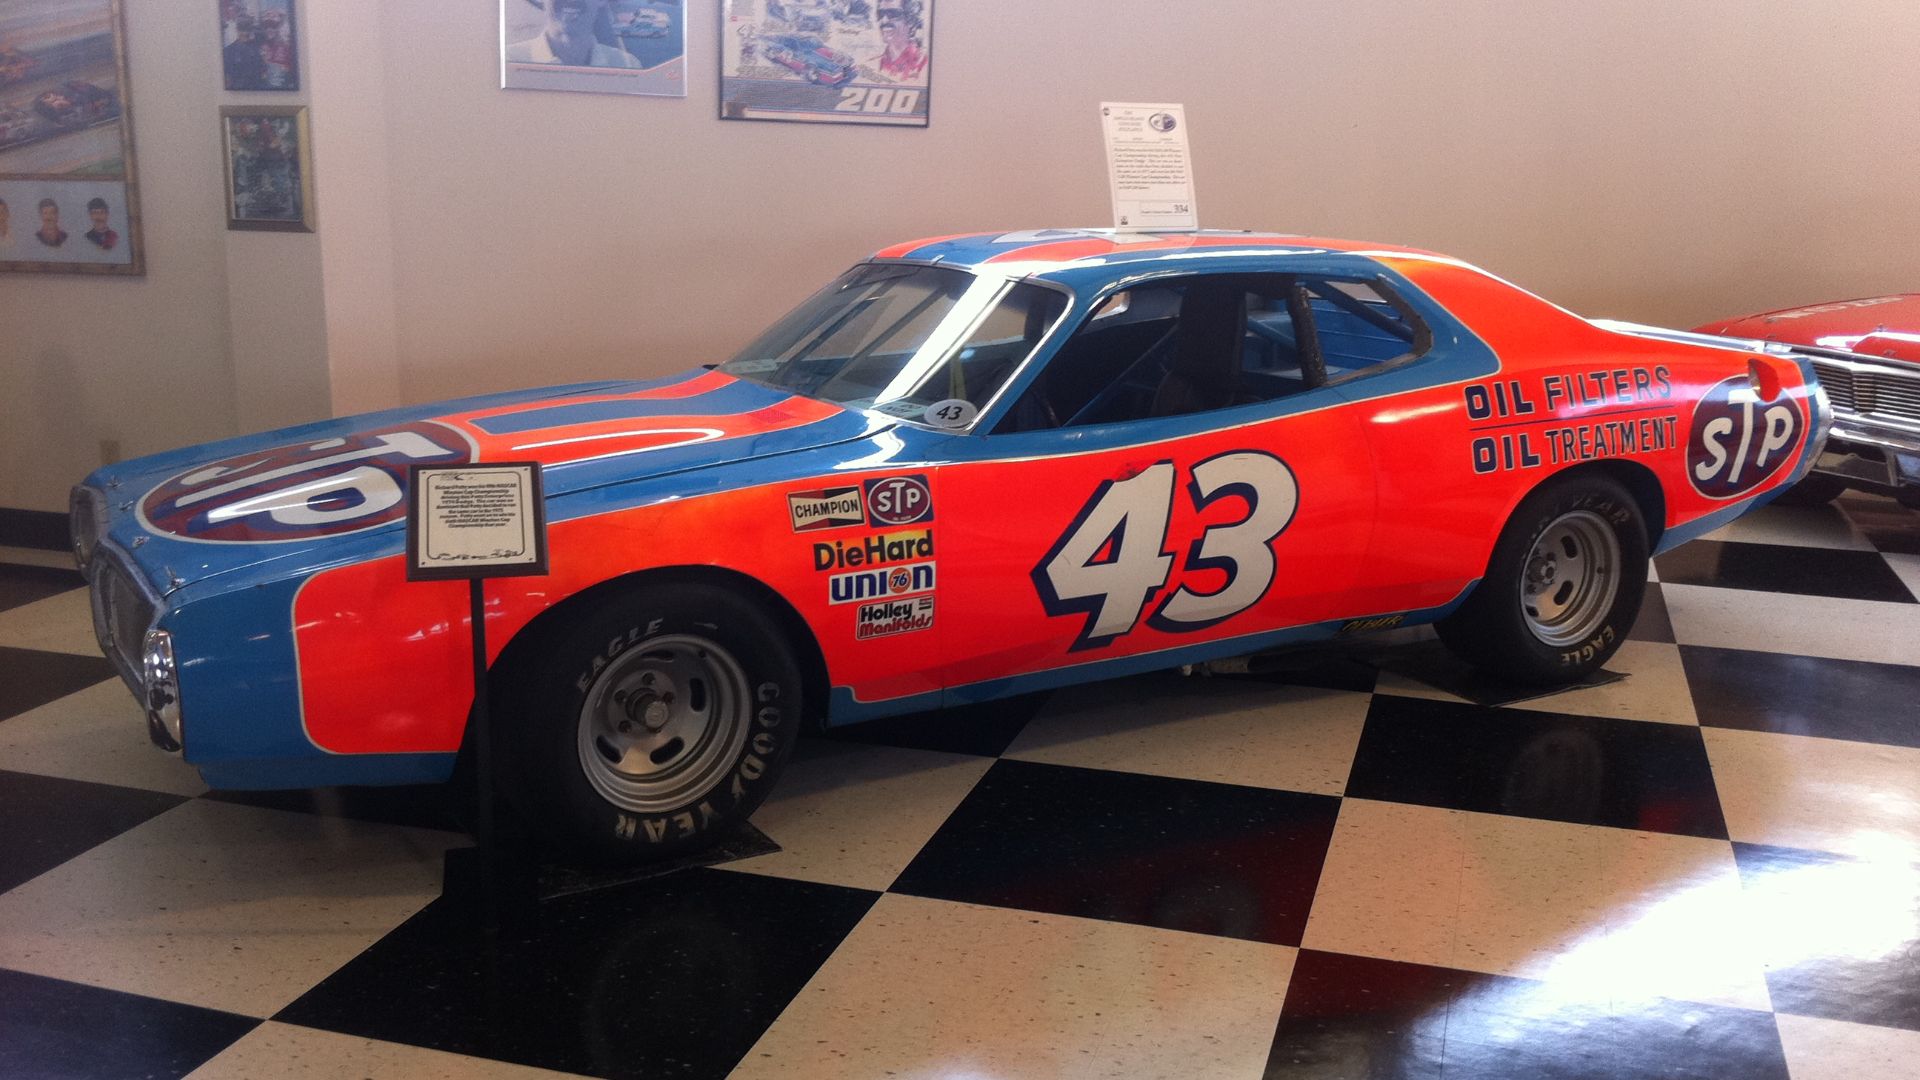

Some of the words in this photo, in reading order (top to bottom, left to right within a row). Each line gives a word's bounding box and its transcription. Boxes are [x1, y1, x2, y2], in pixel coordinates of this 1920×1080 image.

[834, 87, 921, 114] 200
[1464, 379, 1534, 420] OIL
[1543, 365, 1672, 410] FILTERS
[936, 405, 963, 420] 43
[1471, 433, 1541, 474] OIL
[1545, 415, 1679, 465] TREATMENT
[1695, 388, 1795, 484] STP
[794, 498, 860, 519] CHAMPION
[877, 481, 921, 513] STP
[813, 529, 934, 572] DieHard
[1030, 449, 1299, 653] 43
[892, 573, 908, 587] 76
[859, 614, 933, 637] Manifolds
[860, 602, 913, 623] Holley
[576, 617, 664, 694] EAGLE
[1560, 624, 1616, 667] EAGLE
